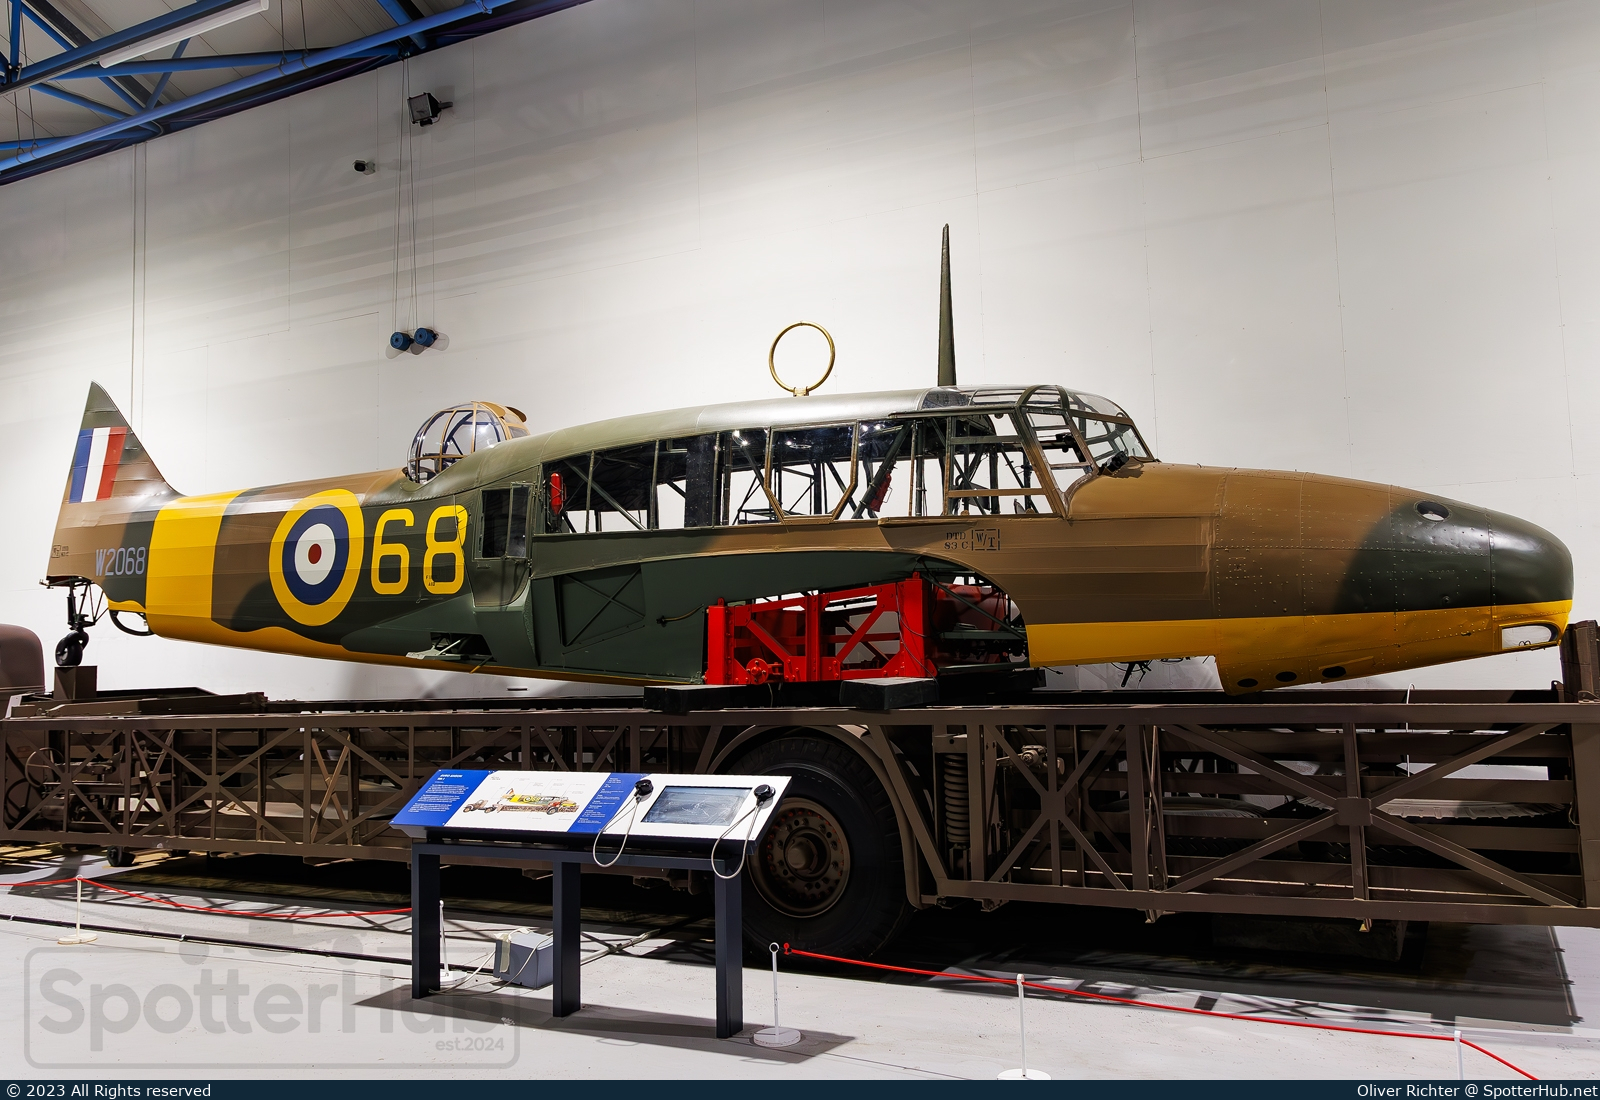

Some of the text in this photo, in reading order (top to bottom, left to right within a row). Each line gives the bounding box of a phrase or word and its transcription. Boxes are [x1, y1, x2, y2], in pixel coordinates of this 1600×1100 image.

[946, 532, 966, 540] DTD
[976, 532, 995, 548] W/T
[371, 504, 468, 594] 68
[961, 541, 969, 550] C
[95, 546, 146, 577] W2068
